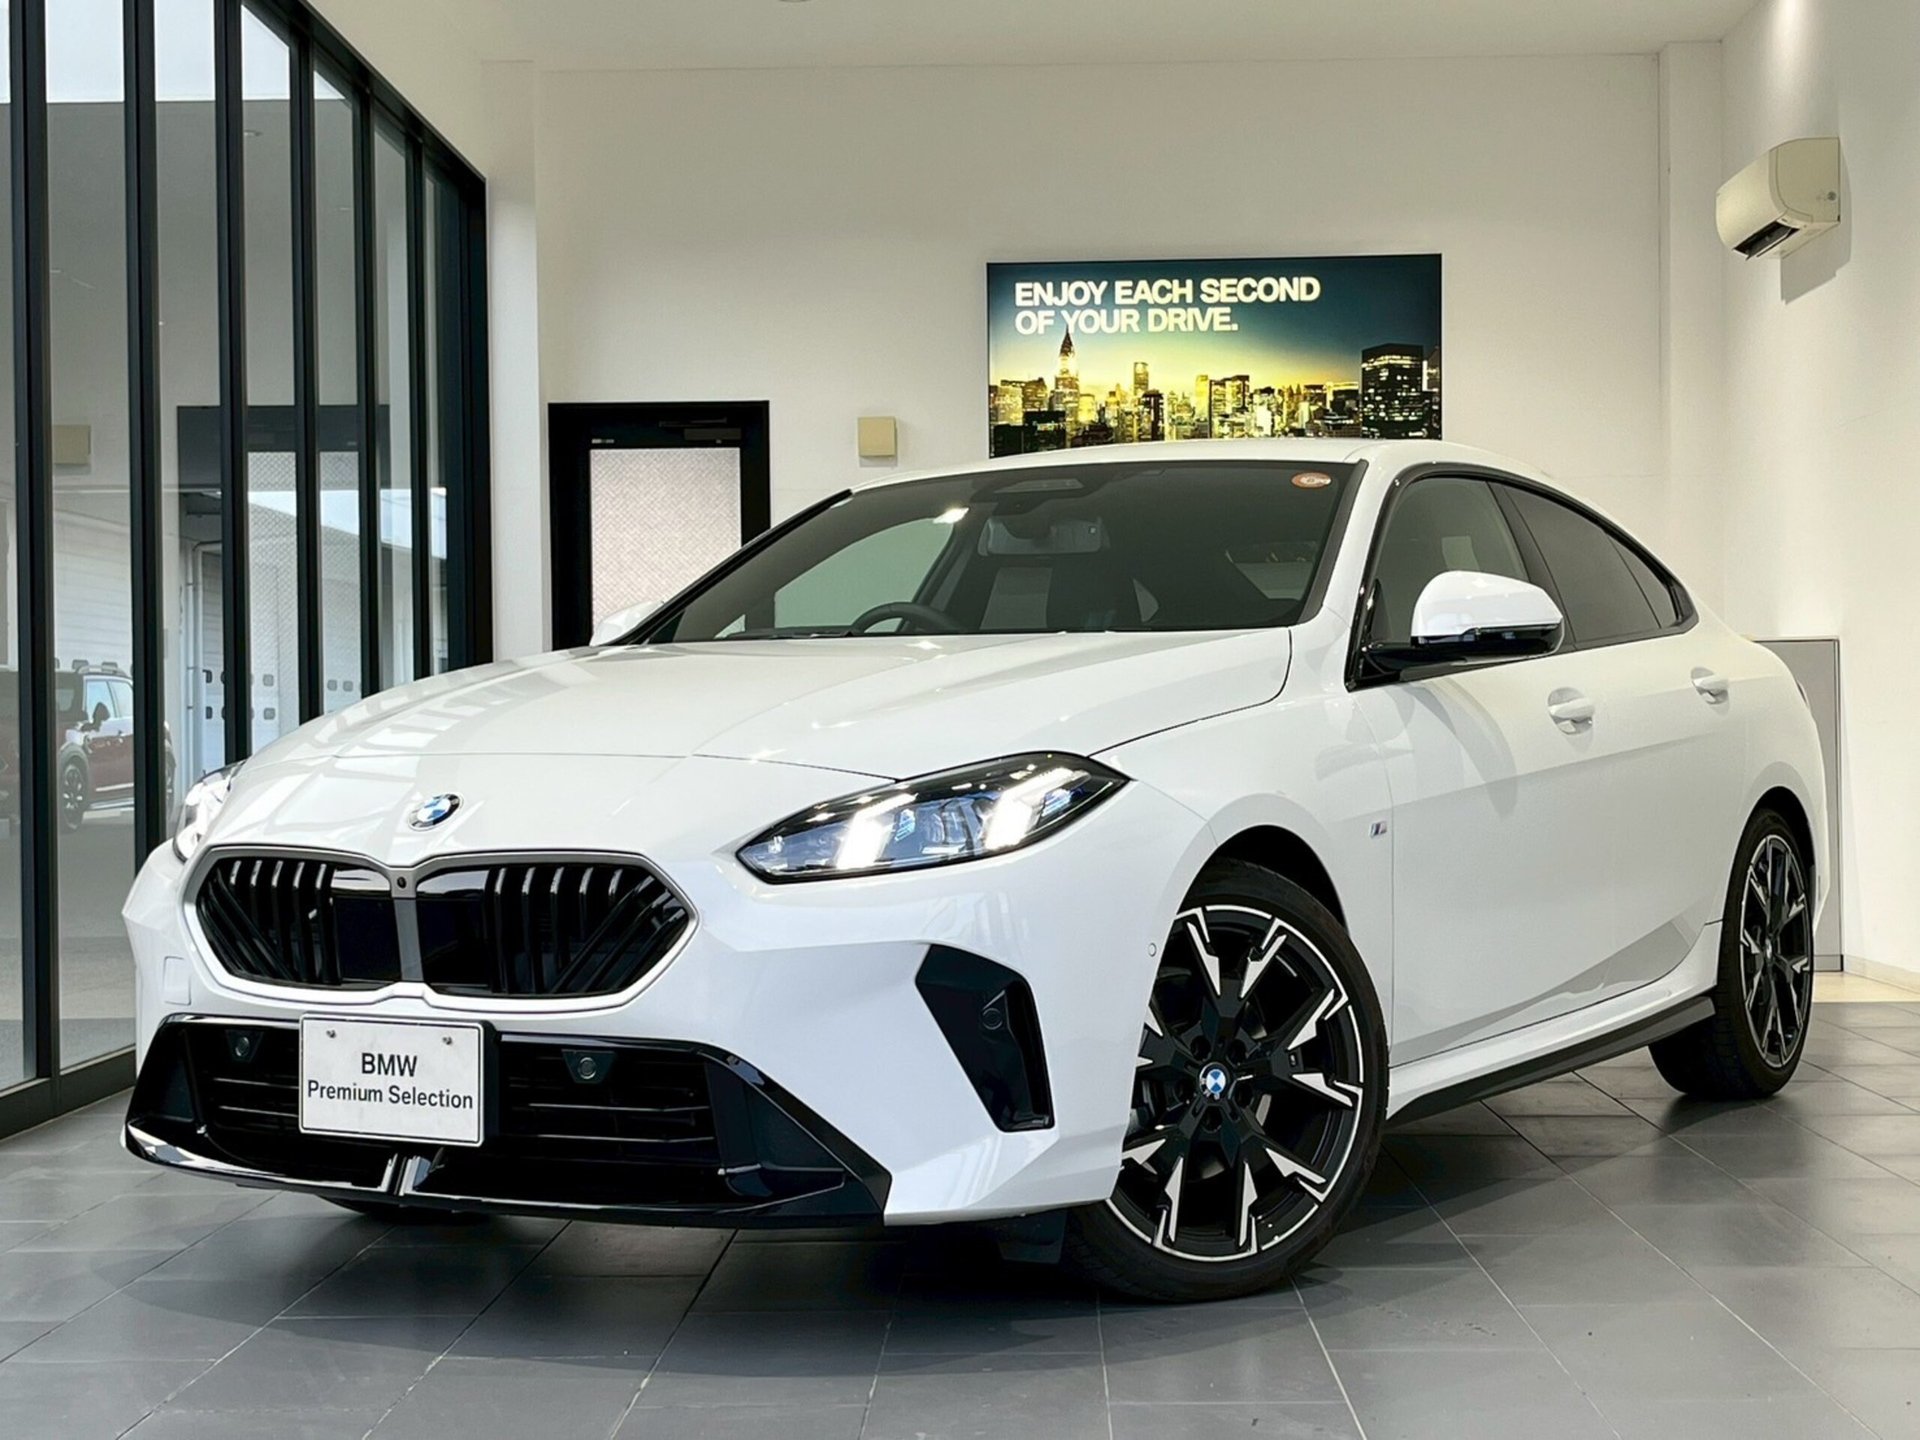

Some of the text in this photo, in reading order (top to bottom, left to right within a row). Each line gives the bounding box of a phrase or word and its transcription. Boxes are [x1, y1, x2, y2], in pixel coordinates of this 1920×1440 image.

[1014, 276, 1321, 307] ENJOY EACH SECOND
[1014, 306, 1239, 335] OF YOUR DRIVE.
[361, 1052, 418, 1077] BMW
[307, 1079, 473, 1109] Premium Selection
